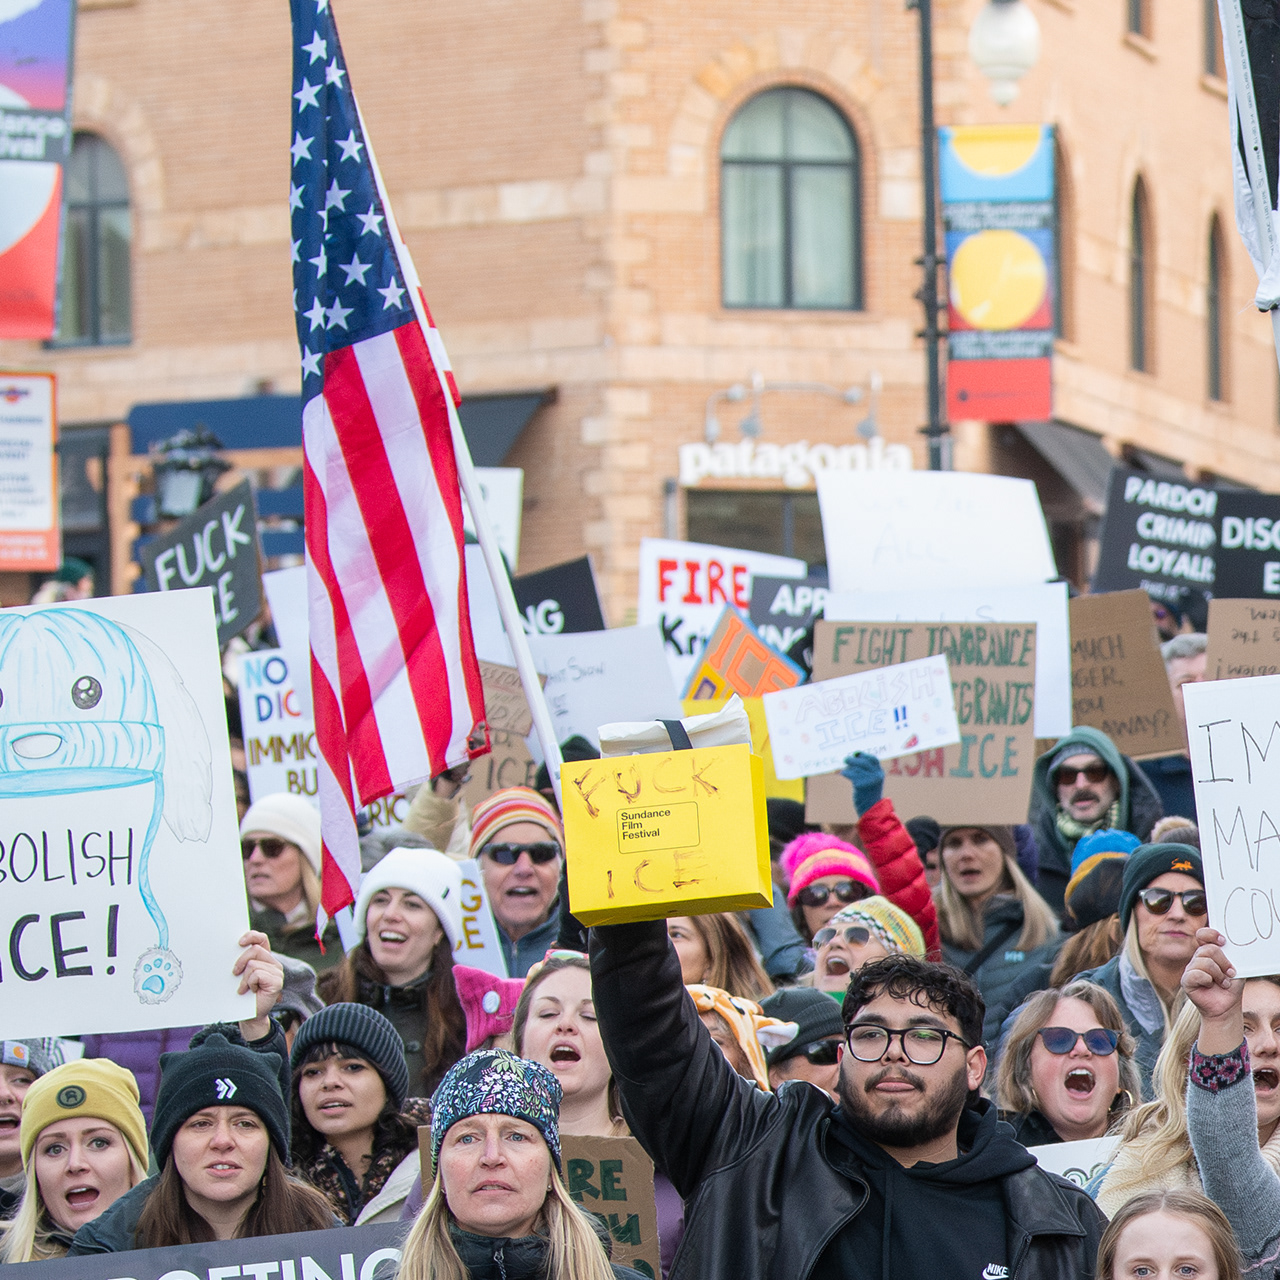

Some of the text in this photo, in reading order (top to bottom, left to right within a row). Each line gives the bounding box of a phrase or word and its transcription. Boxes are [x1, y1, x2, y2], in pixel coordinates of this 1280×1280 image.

[679, 437, 913, 487] patagonia
[154, 504, 251, 593] FUCK
[657, 558, 749, 609] FIRE
[832, 627, 915, 665] FIGHT
[927, 626, 1035, 667] IGNORANCE
[243, 656, 288, 689] NO
[256, 689, 302, 722] DIC
[949, 733, 1019, 779] ICE
[570, 756, 720, 819] FUCK
[620, 808, 671, 821] Sundance
[621, 821, 643, 830] Film
[622, 828, 661, 841] Festival
[605, 848, 719, 899] ICE
[985, 1262, 1009, 1276] NIKE
